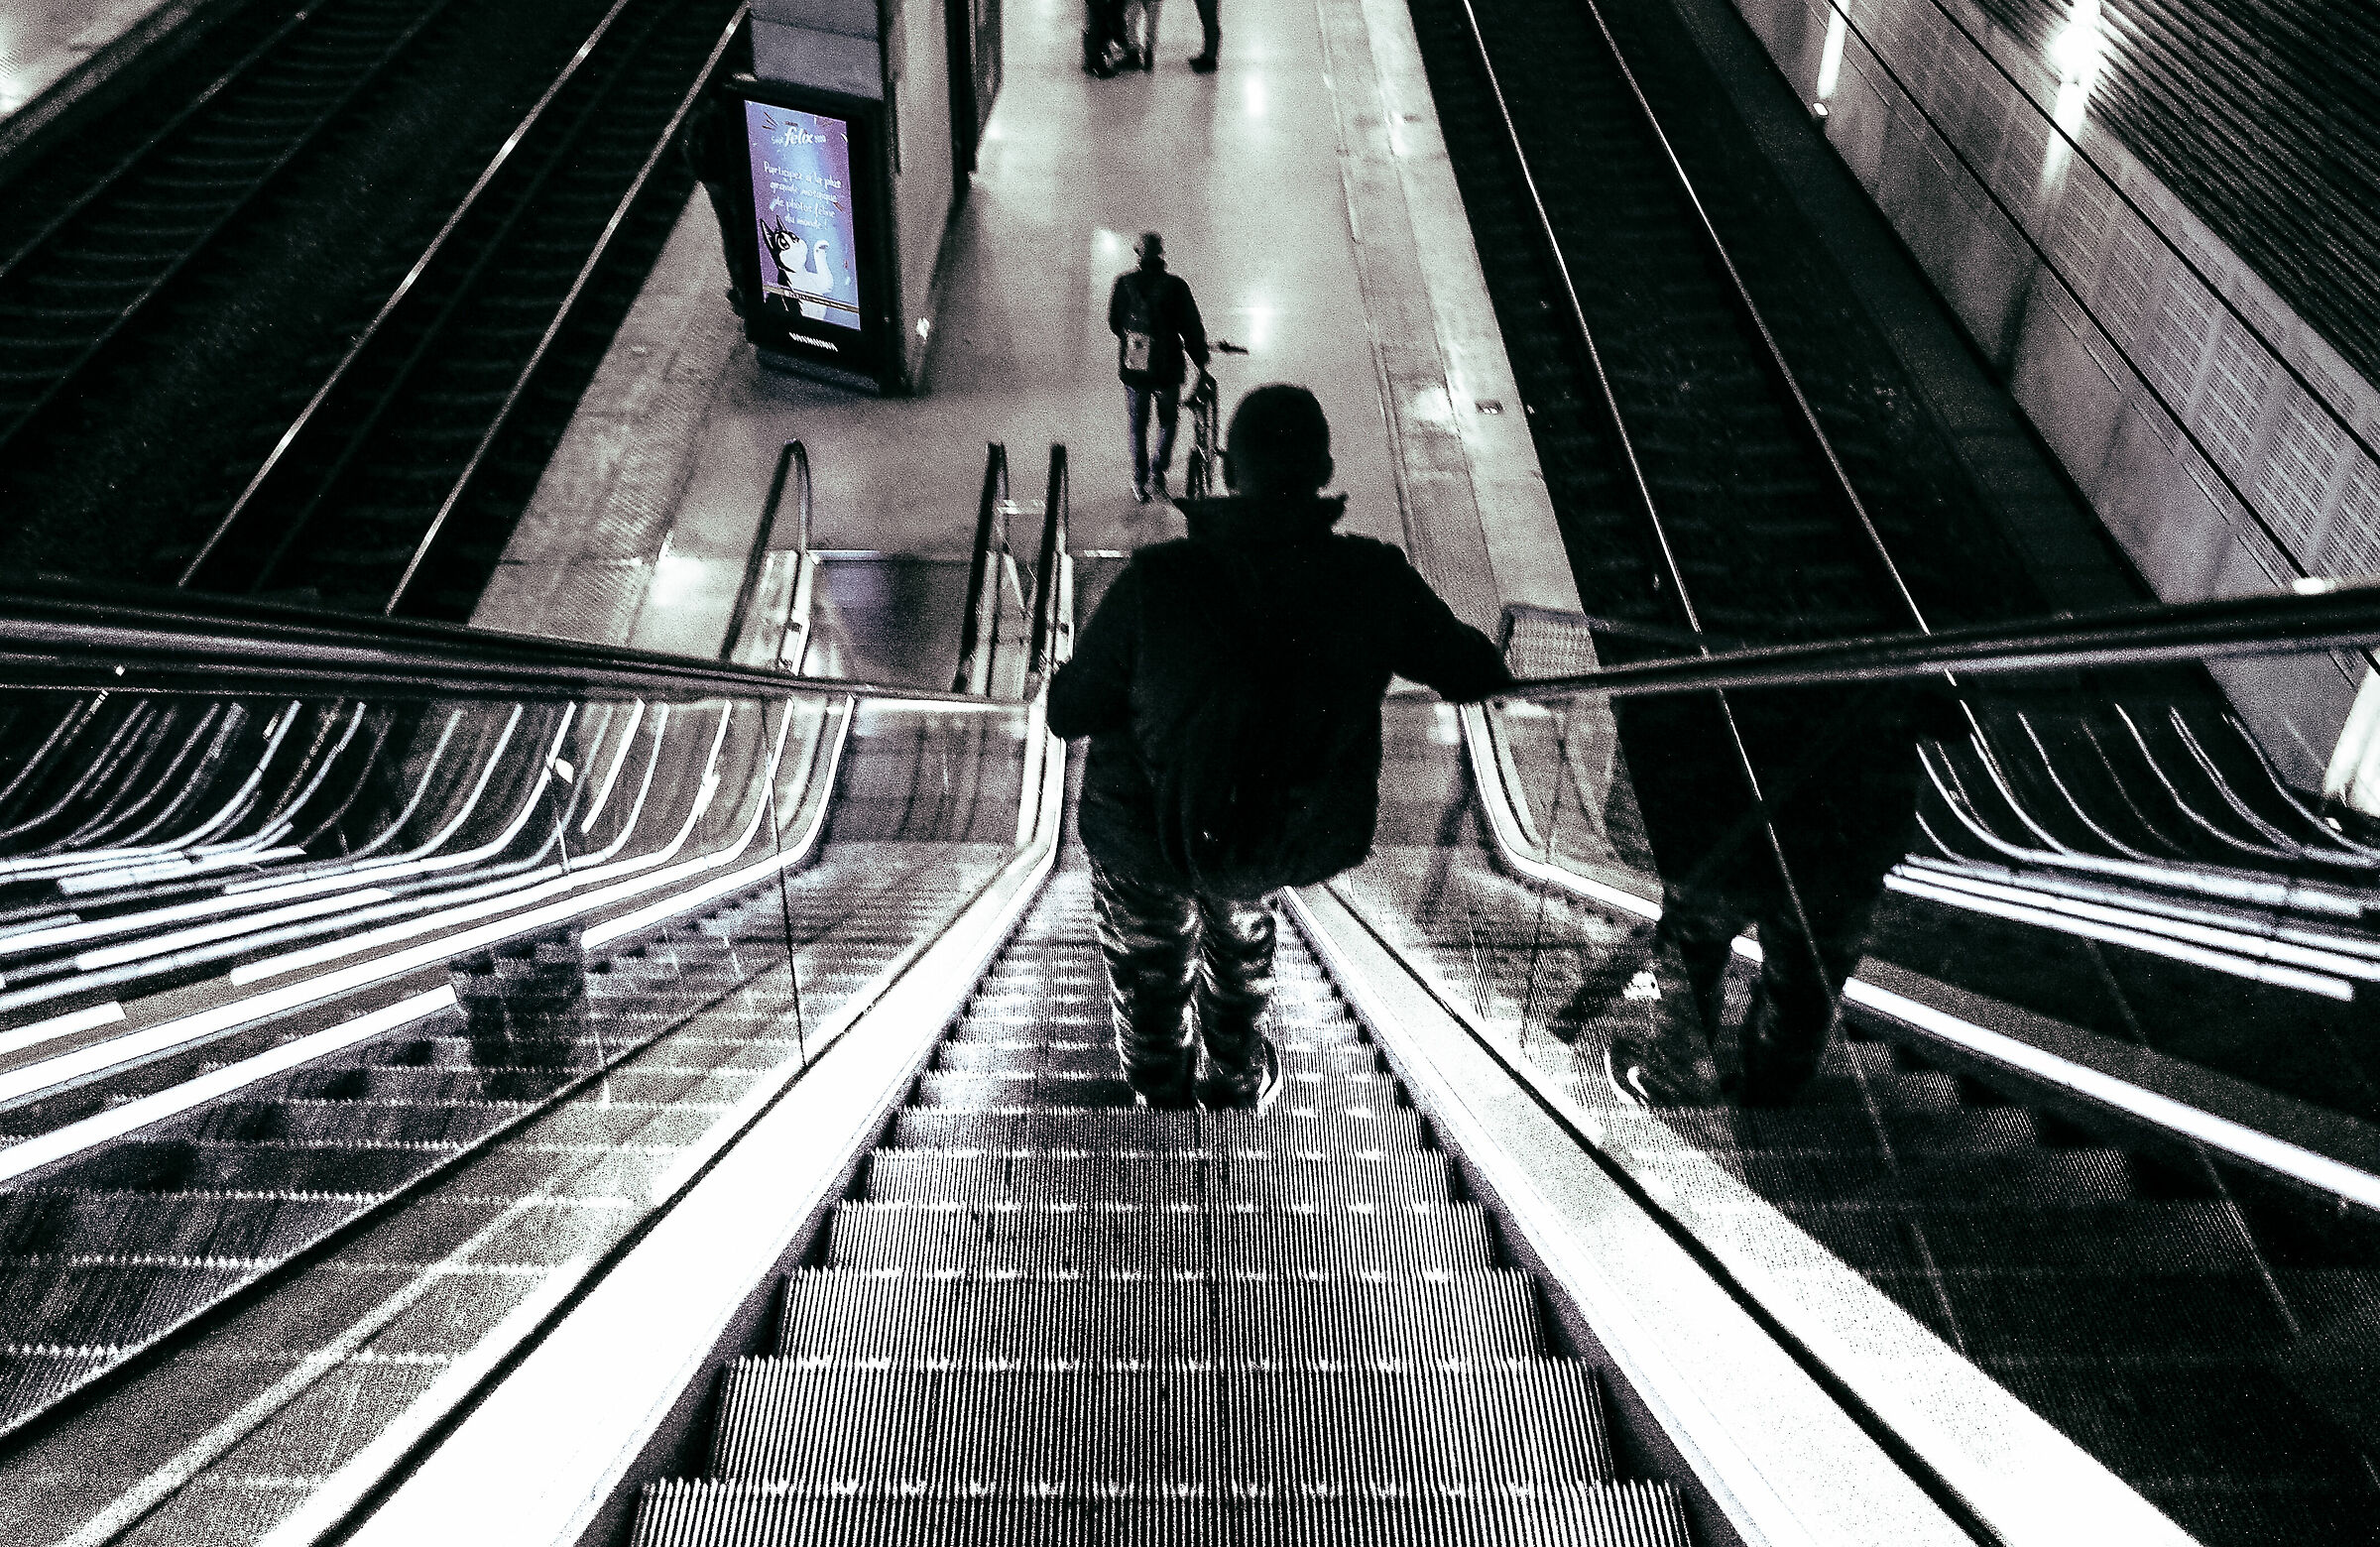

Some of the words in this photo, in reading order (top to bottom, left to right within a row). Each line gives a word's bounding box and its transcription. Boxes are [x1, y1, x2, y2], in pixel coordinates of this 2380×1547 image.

[764, 161, 801, 182] Participez
[824, 175, 842, 189] plus
[770, 181, 797, 194] grande
[786, 197, 812, 212] photos
[797, 217, 822, 229] monde
